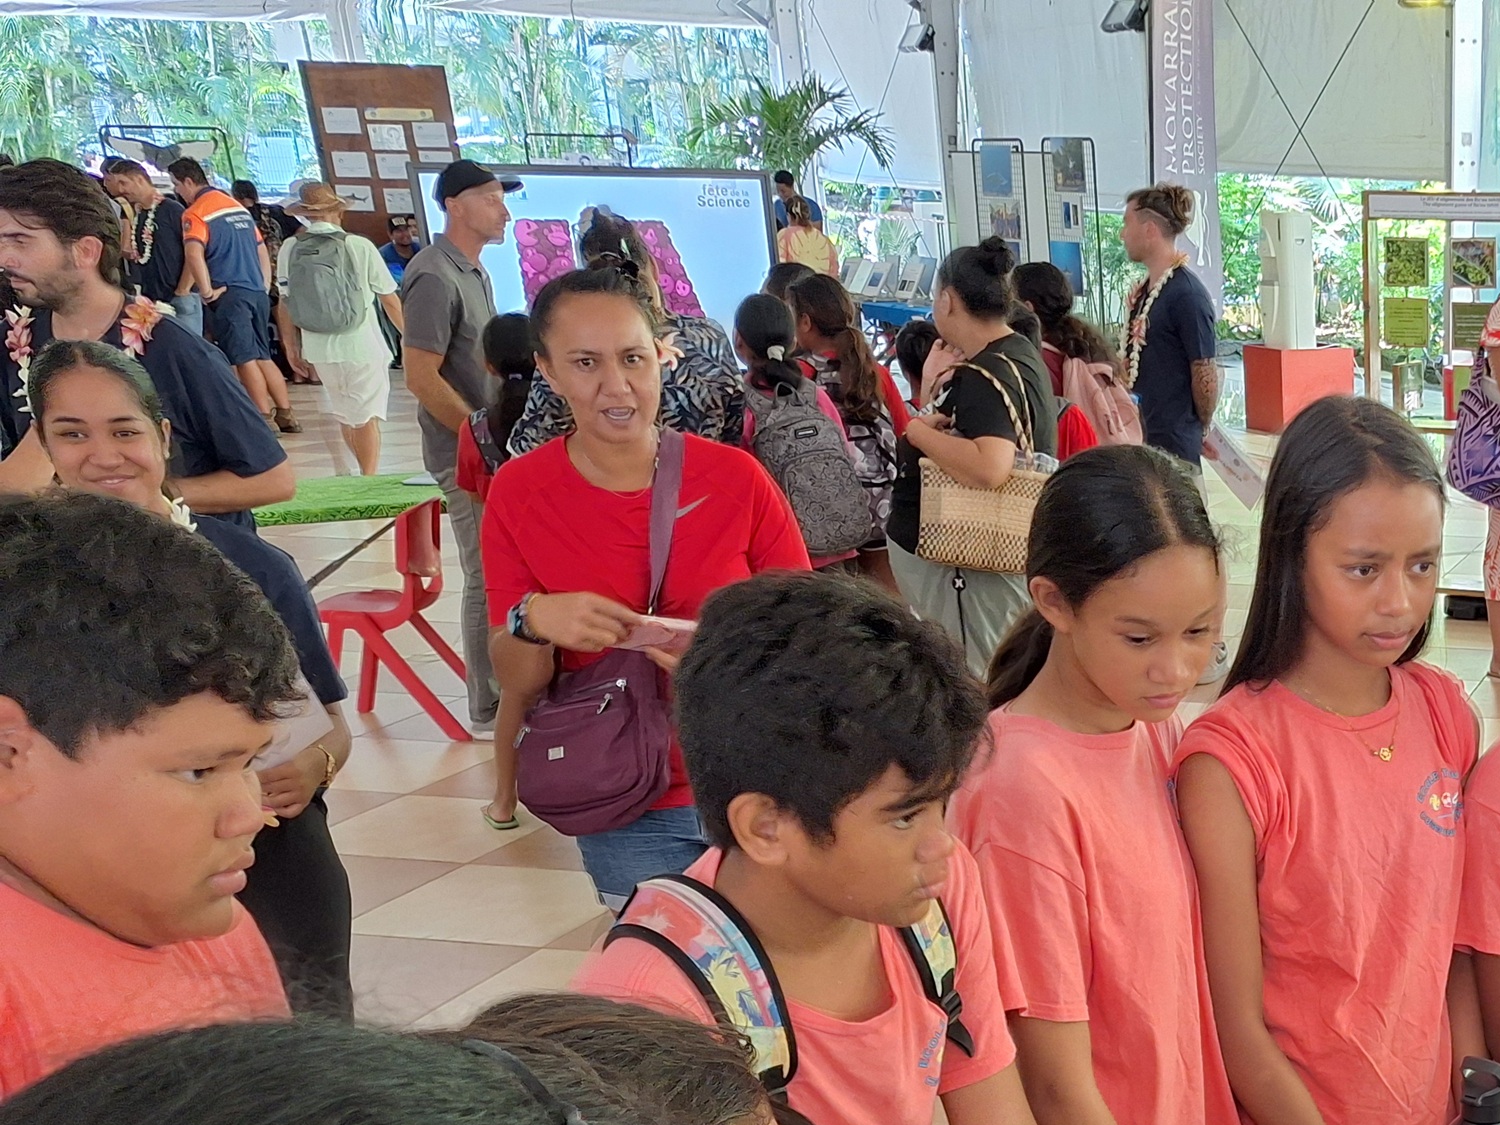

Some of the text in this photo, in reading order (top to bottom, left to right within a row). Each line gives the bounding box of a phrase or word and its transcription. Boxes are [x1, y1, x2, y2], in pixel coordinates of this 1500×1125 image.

[1164, 0, 1179, 174] MOKARRA
[1180, 0, 1195, 175] PROTECTIO
[1195, 114, 1205, 175] SOCIETY
[697, 195, 750, 208] Science
[702, 184, 749, 197] fête de la
